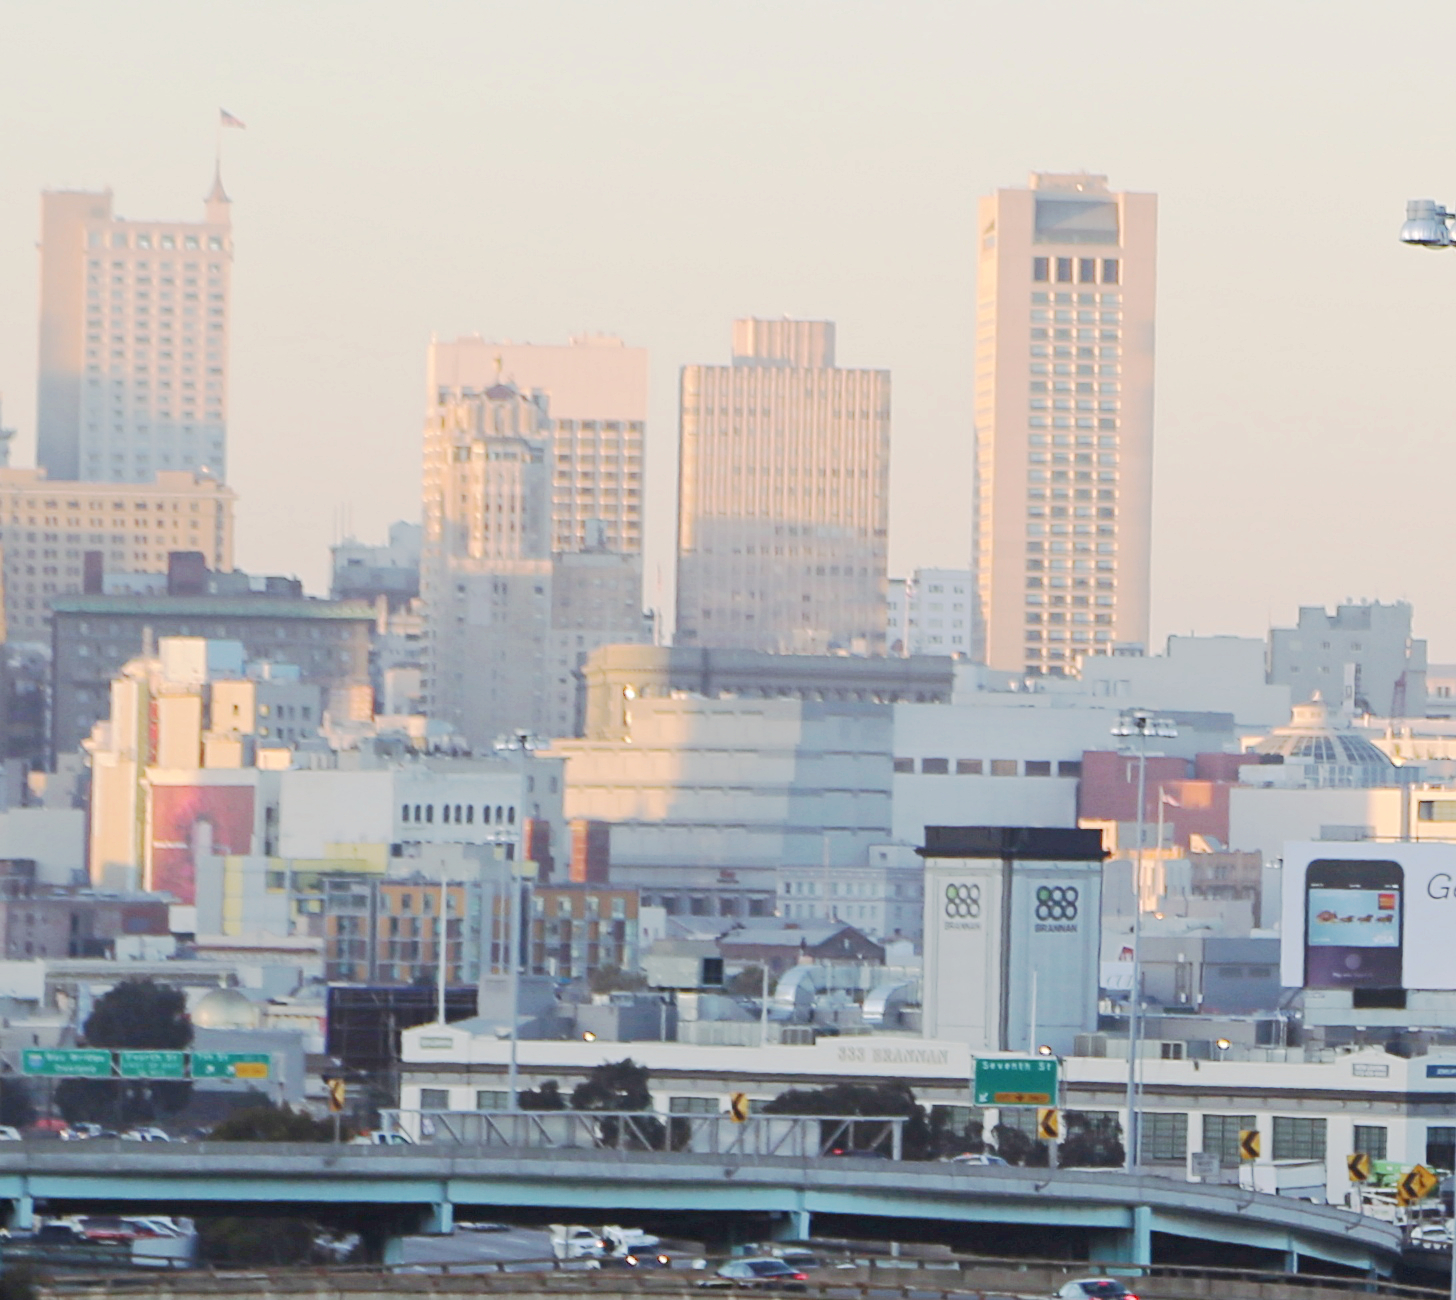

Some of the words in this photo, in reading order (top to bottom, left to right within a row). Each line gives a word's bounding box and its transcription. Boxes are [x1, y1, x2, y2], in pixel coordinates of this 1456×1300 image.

[1034, 923, 1078, 934] BRANNAN
[873, 1047, 949, 1065] BRANNAN
[982, 1060, 1031, 1071] Seventh
[1038, 1061, 1053, 1072] St
